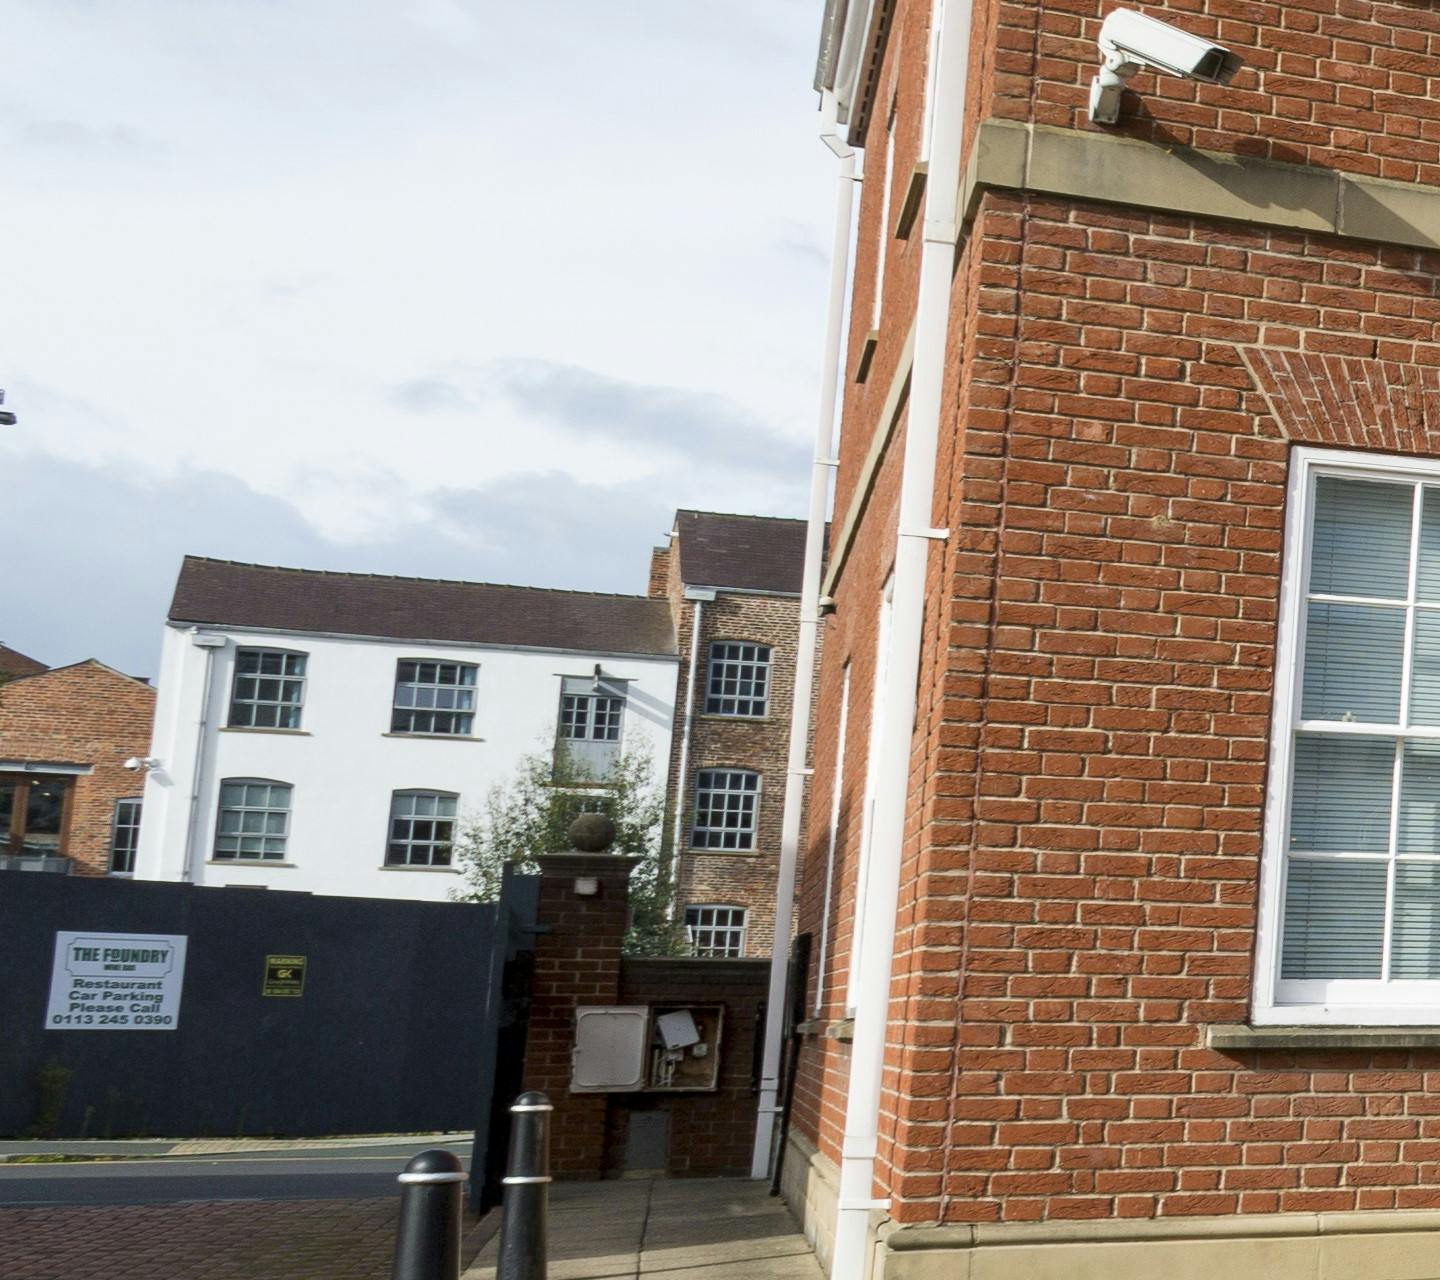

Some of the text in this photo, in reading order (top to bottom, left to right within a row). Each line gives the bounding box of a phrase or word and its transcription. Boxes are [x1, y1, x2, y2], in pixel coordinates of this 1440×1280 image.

[73, 947, 169, 963] THE FOUNDRY
[73, 979, 163, 990] Restaurant
[69, 991, 164, 1003] Car Parking
[69, 1003, 161, 1013] Please Call
[52, 1015, 173, 1025] 0113 245 0390
